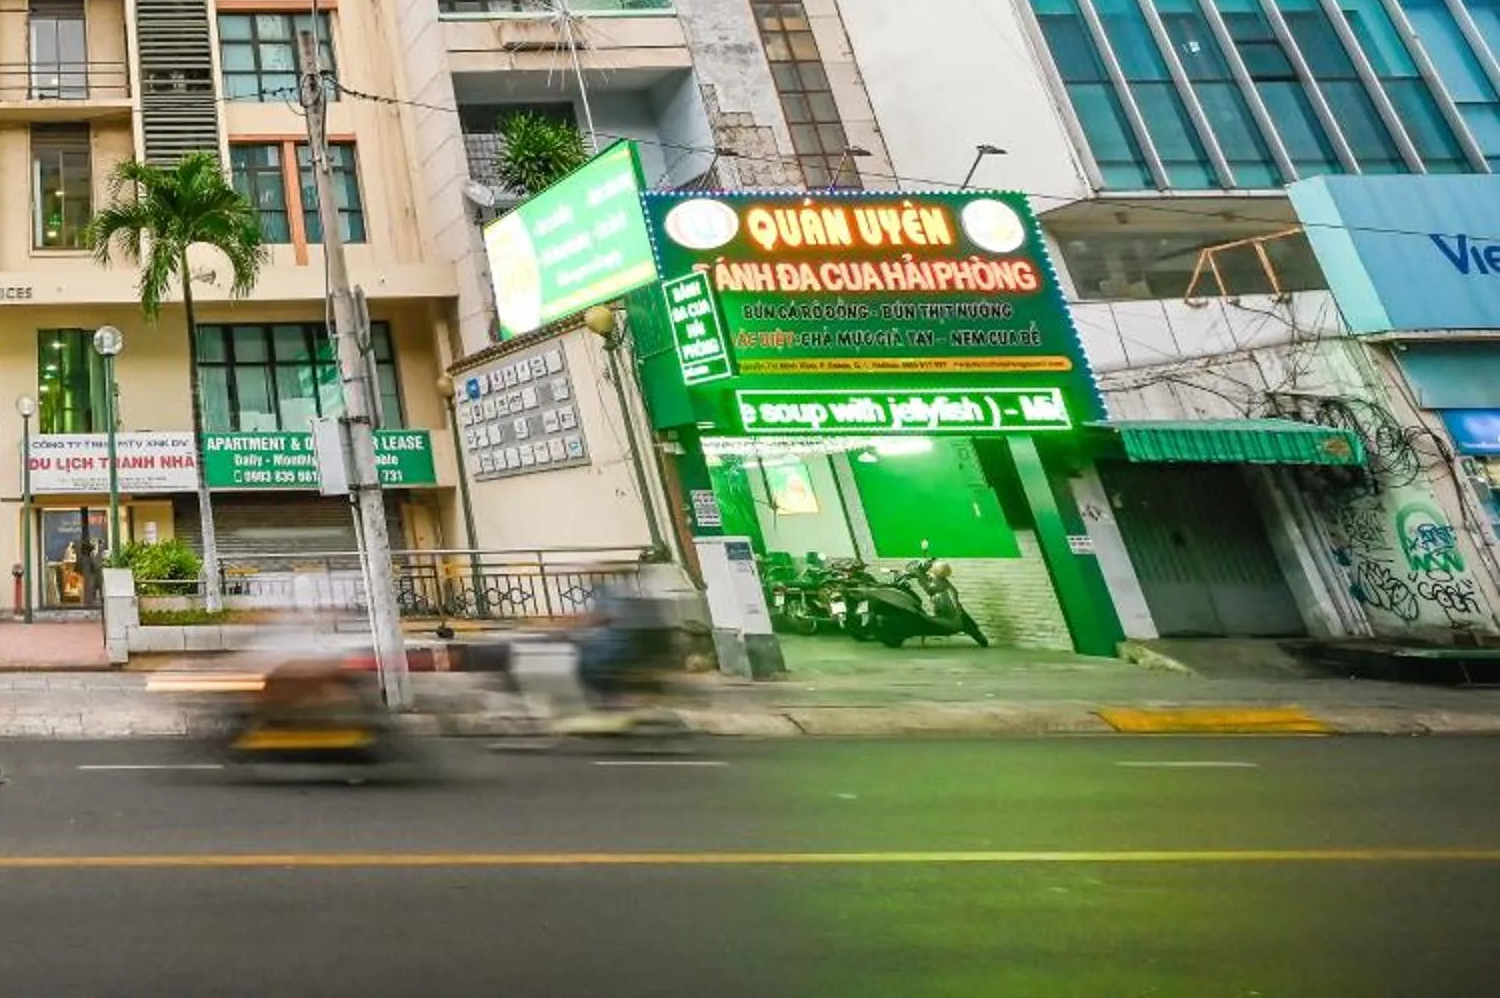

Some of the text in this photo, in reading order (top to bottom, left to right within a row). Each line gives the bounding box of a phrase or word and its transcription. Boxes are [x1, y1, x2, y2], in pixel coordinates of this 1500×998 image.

[747, 198, 952, 251] QUÁN UYÊN
[692, 256, 775, 292] ÁNH
[777, 262, 821, 292] ĐA
[821, 262, 885, 291] CUA
[760, 402, 829, 430] soup
[828, 397, 886, 422] with
[207, 437, 285, 451] APARTMENT
[382, 436, 424, 450] LEASE
